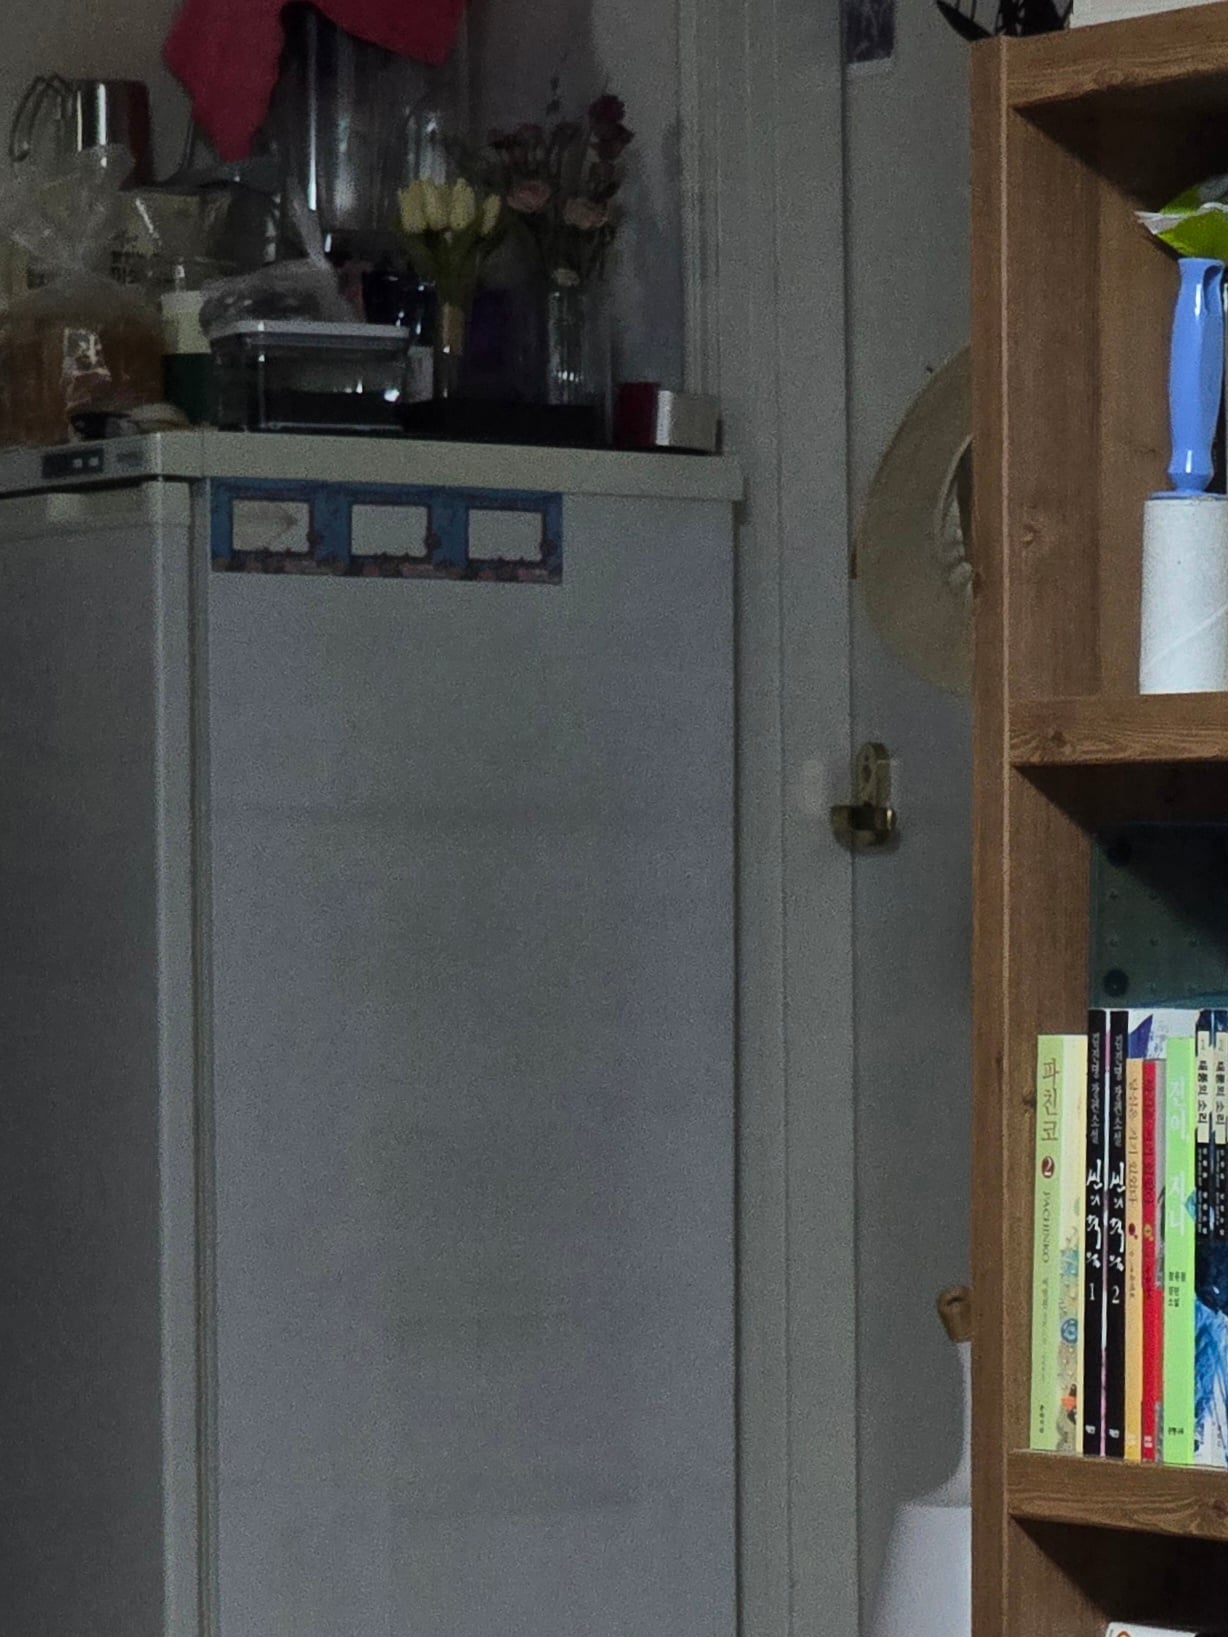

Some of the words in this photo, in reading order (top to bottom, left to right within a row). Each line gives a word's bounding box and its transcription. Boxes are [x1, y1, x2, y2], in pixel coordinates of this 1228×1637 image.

[1041, 1057, 1060, 1142] 파친코
[1198, 1099, 1208, 1125] 소리
[1215, 1101, 1225, 1126] 소리
[1167, 1171, 1185, 1237] 지니
[1042, 1191, 1051, 1263] PACHINKO
[1088, 1282, 1096, 1302] 1
[1111, 1286, 1120, 1304] 2
